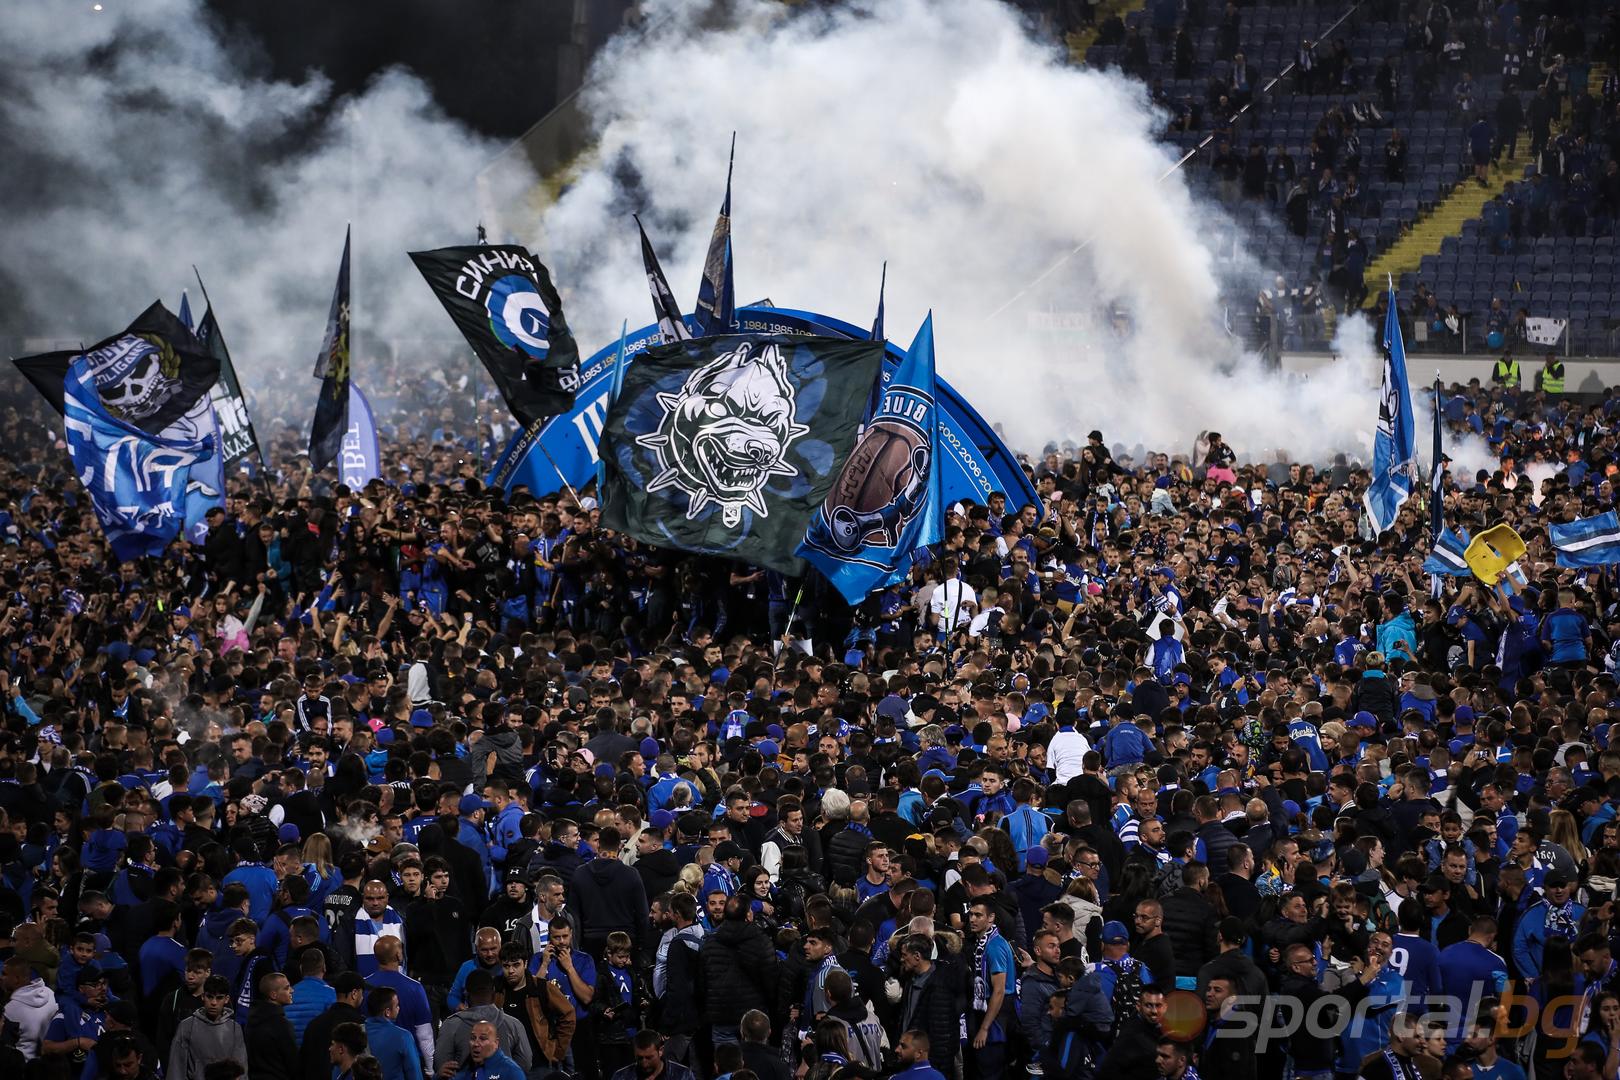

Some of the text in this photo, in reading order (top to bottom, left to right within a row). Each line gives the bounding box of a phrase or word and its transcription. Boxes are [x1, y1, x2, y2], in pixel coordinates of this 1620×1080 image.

[509, 440, 527, 465] 1946
[526, 418, 543, 442] 147
[581, 363, 602, 384] 1953
[624, 338, 647, 356] 1968
[647, 332, 662, 346] 197
[743, 320, 767, 331] 1984
[769, 323, 793, 335] 1985
[938, 421, 961, 449] 2002
[959, 447, 982, 477] 2006
